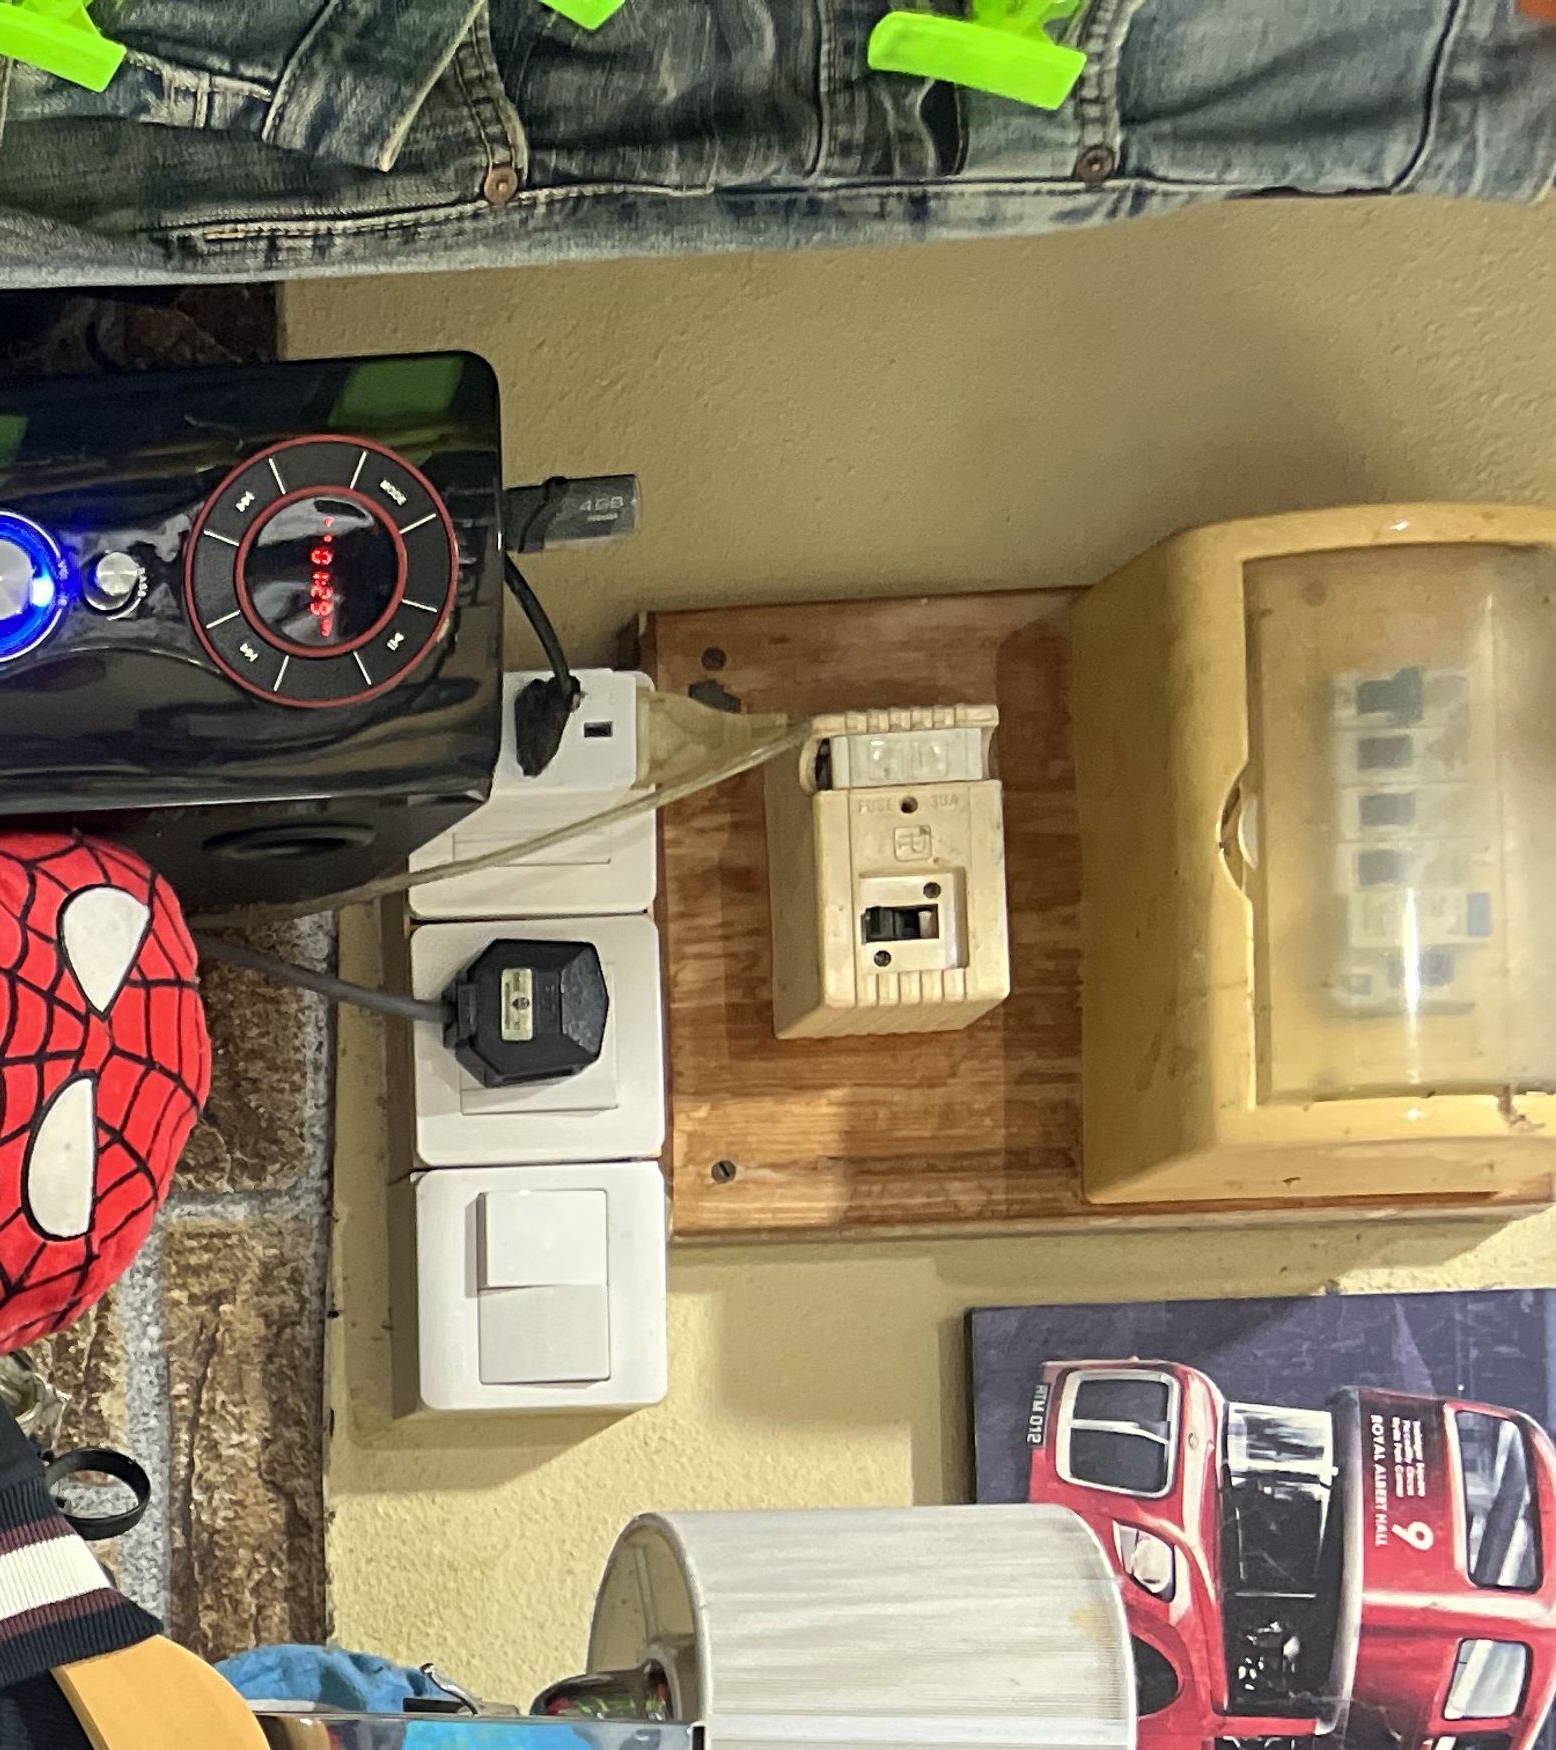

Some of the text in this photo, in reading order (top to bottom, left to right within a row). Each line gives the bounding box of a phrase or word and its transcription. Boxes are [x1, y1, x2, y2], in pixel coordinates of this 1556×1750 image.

[136, 566, 149, 598] BASS
[1369, 1414, 1389, 1547] ROYAL ALBERT HALL
[1391, 1521, 1435, 1551] 9
